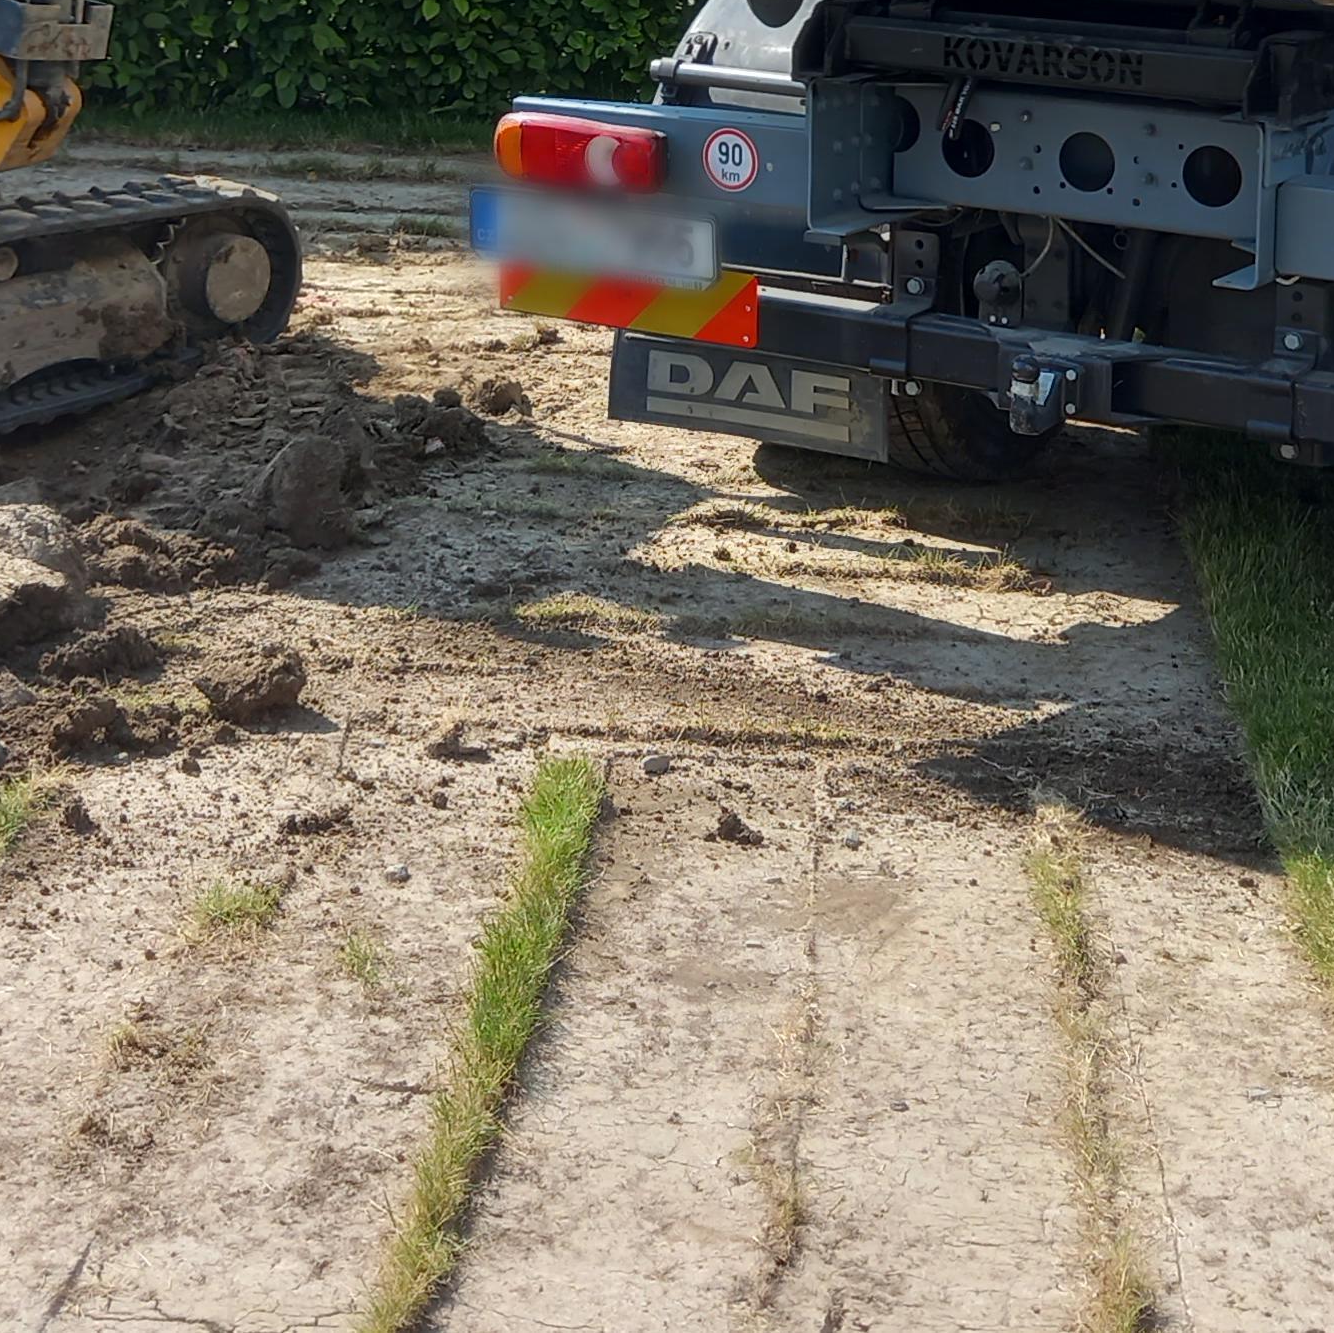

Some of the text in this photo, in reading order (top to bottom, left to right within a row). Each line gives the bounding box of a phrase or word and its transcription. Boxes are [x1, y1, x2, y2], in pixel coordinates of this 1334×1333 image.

[943, 36, 1144, 86] KOVARSON
[718, 141, 743, 167] 90
[721, 168, 740, 182] km
[646, 349, 851, 415] DAF
